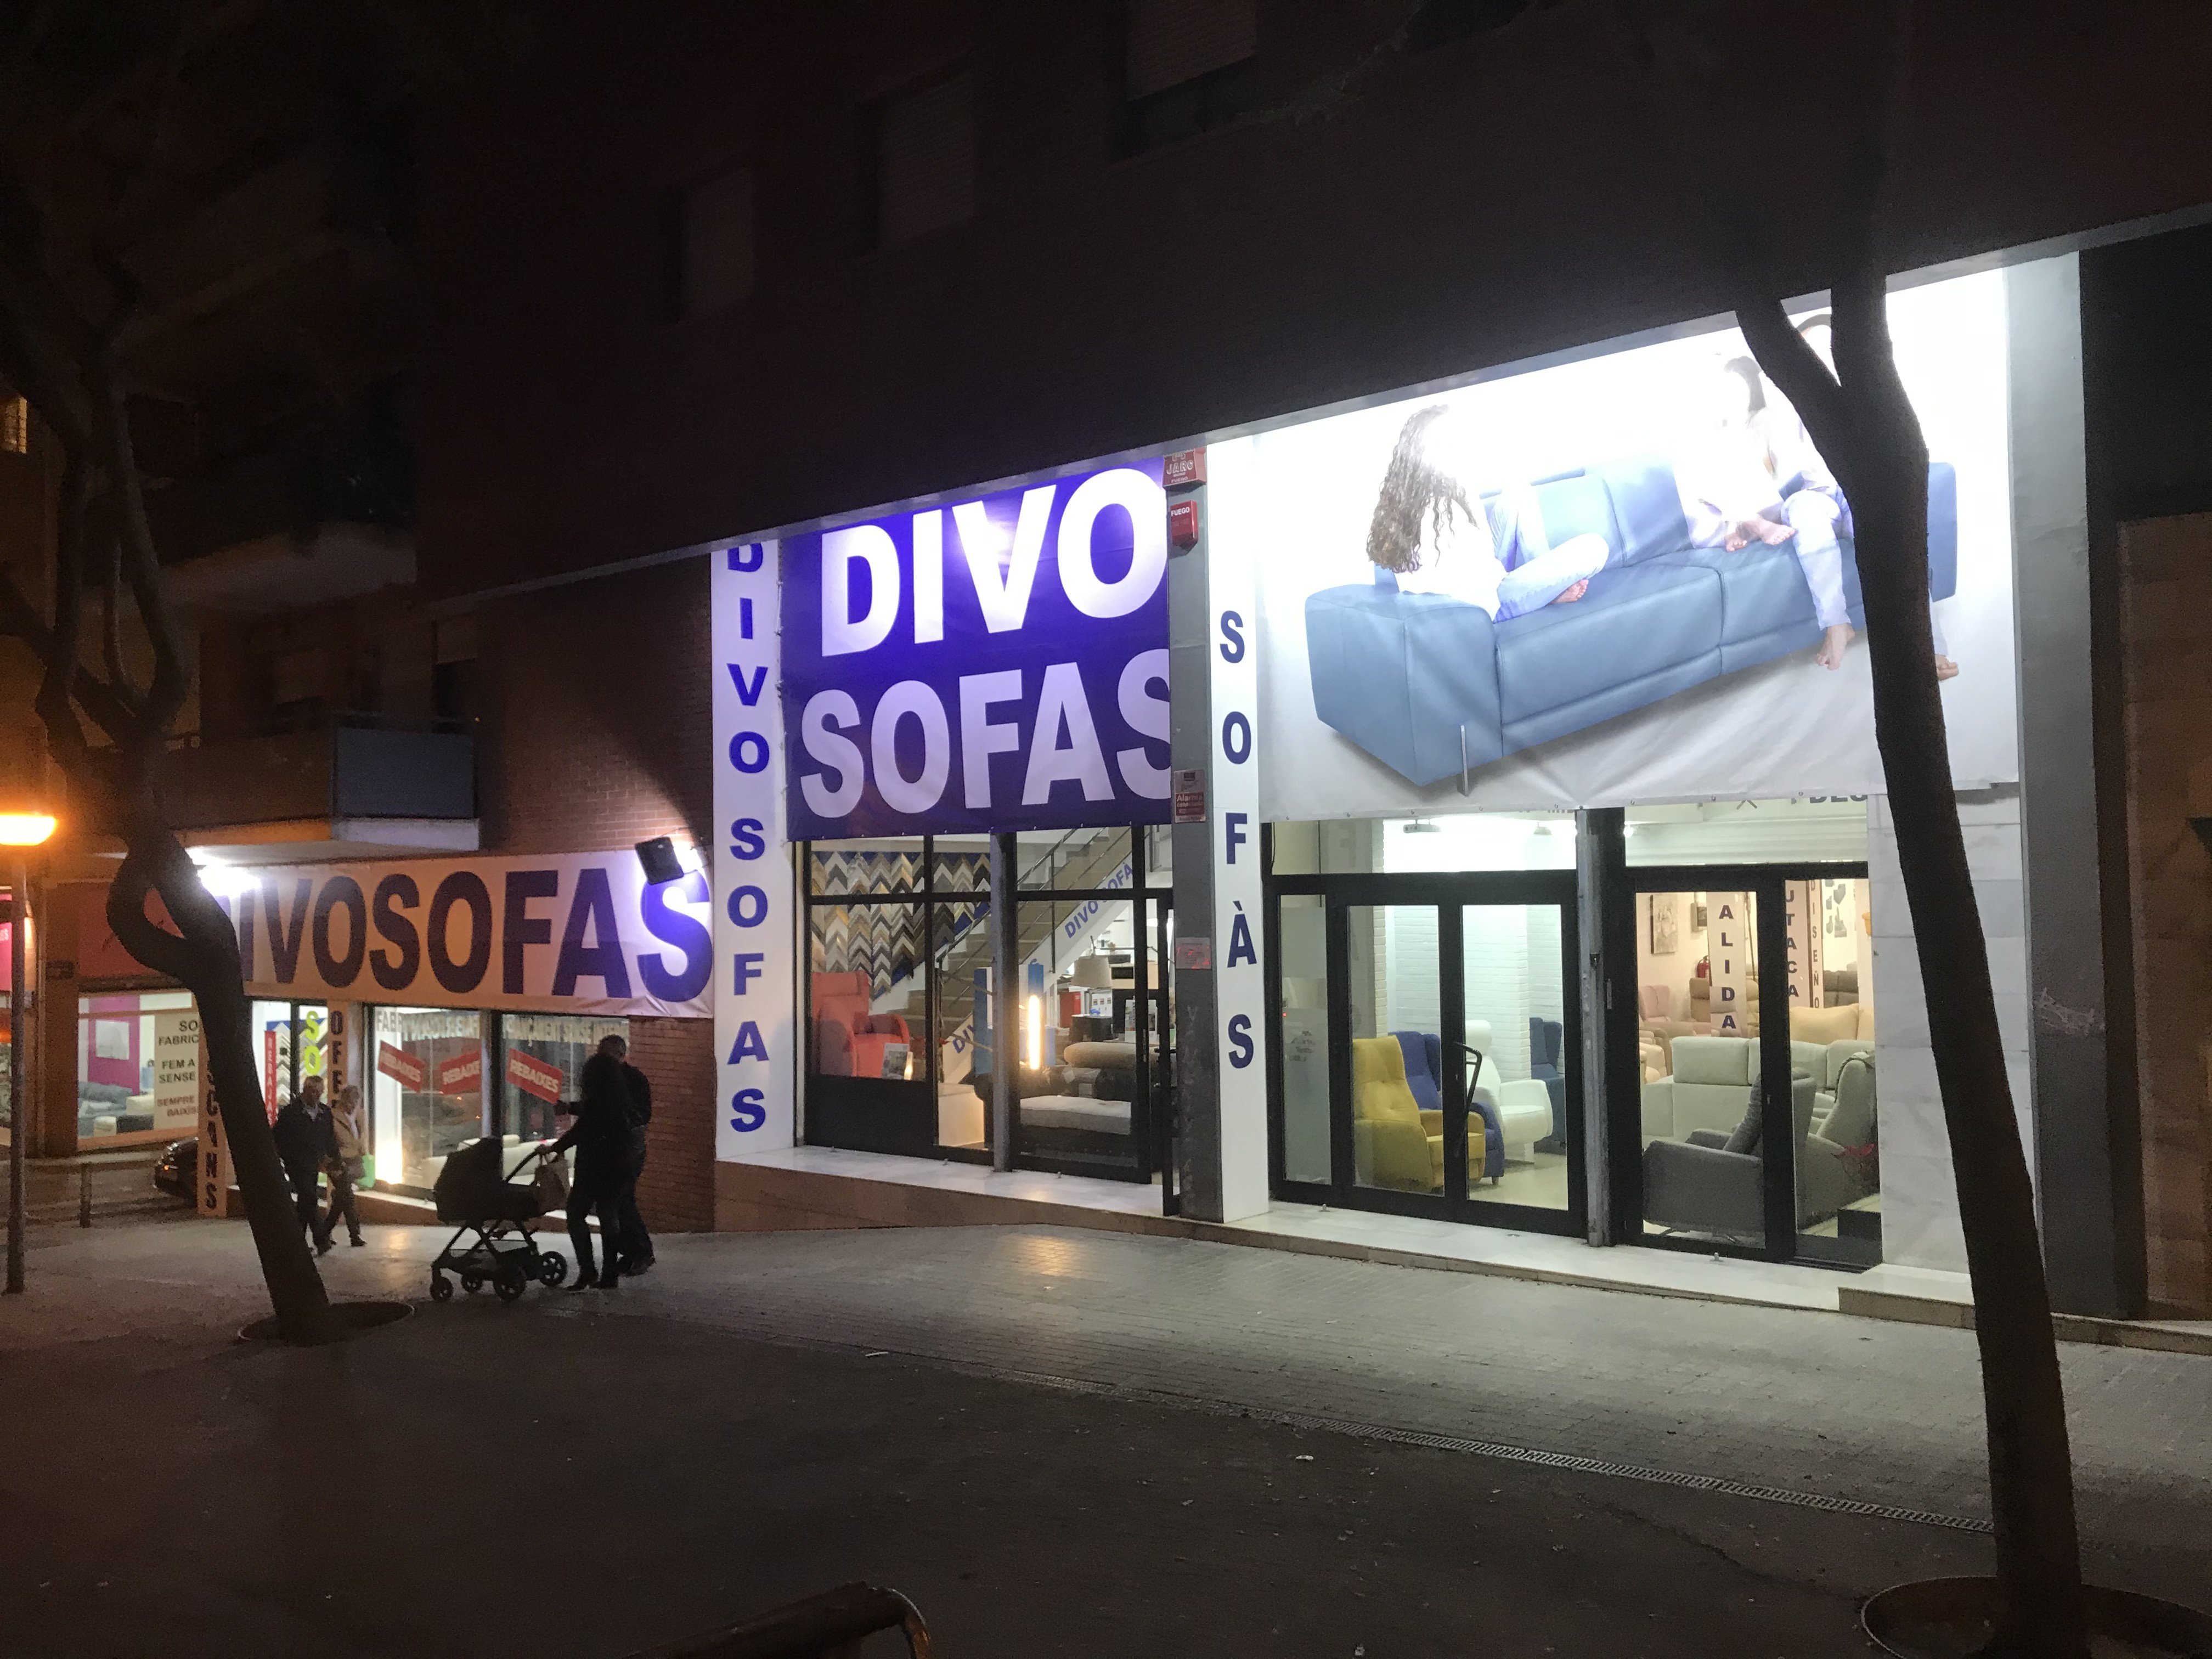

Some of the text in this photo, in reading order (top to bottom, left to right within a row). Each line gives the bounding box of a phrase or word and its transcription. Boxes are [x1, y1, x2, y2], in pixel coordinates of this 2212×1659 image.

[1171, 506, 1190, 517] FUEGO
[822, 468, 1168, 657] DIVO
[800, 649, 1171, 818] SOFAS
[1220, 611, 1257, 1069] SOFÀS
[215, 868, 714, 1003] IVOSOFAS
[1064, 900, 1099, 939] DIVO
[159, 1071, 196, 1084] SENSE
[162, 1058, 195, 1070] FEM A
[510, 1059, 559, 1093] REBAIXES
